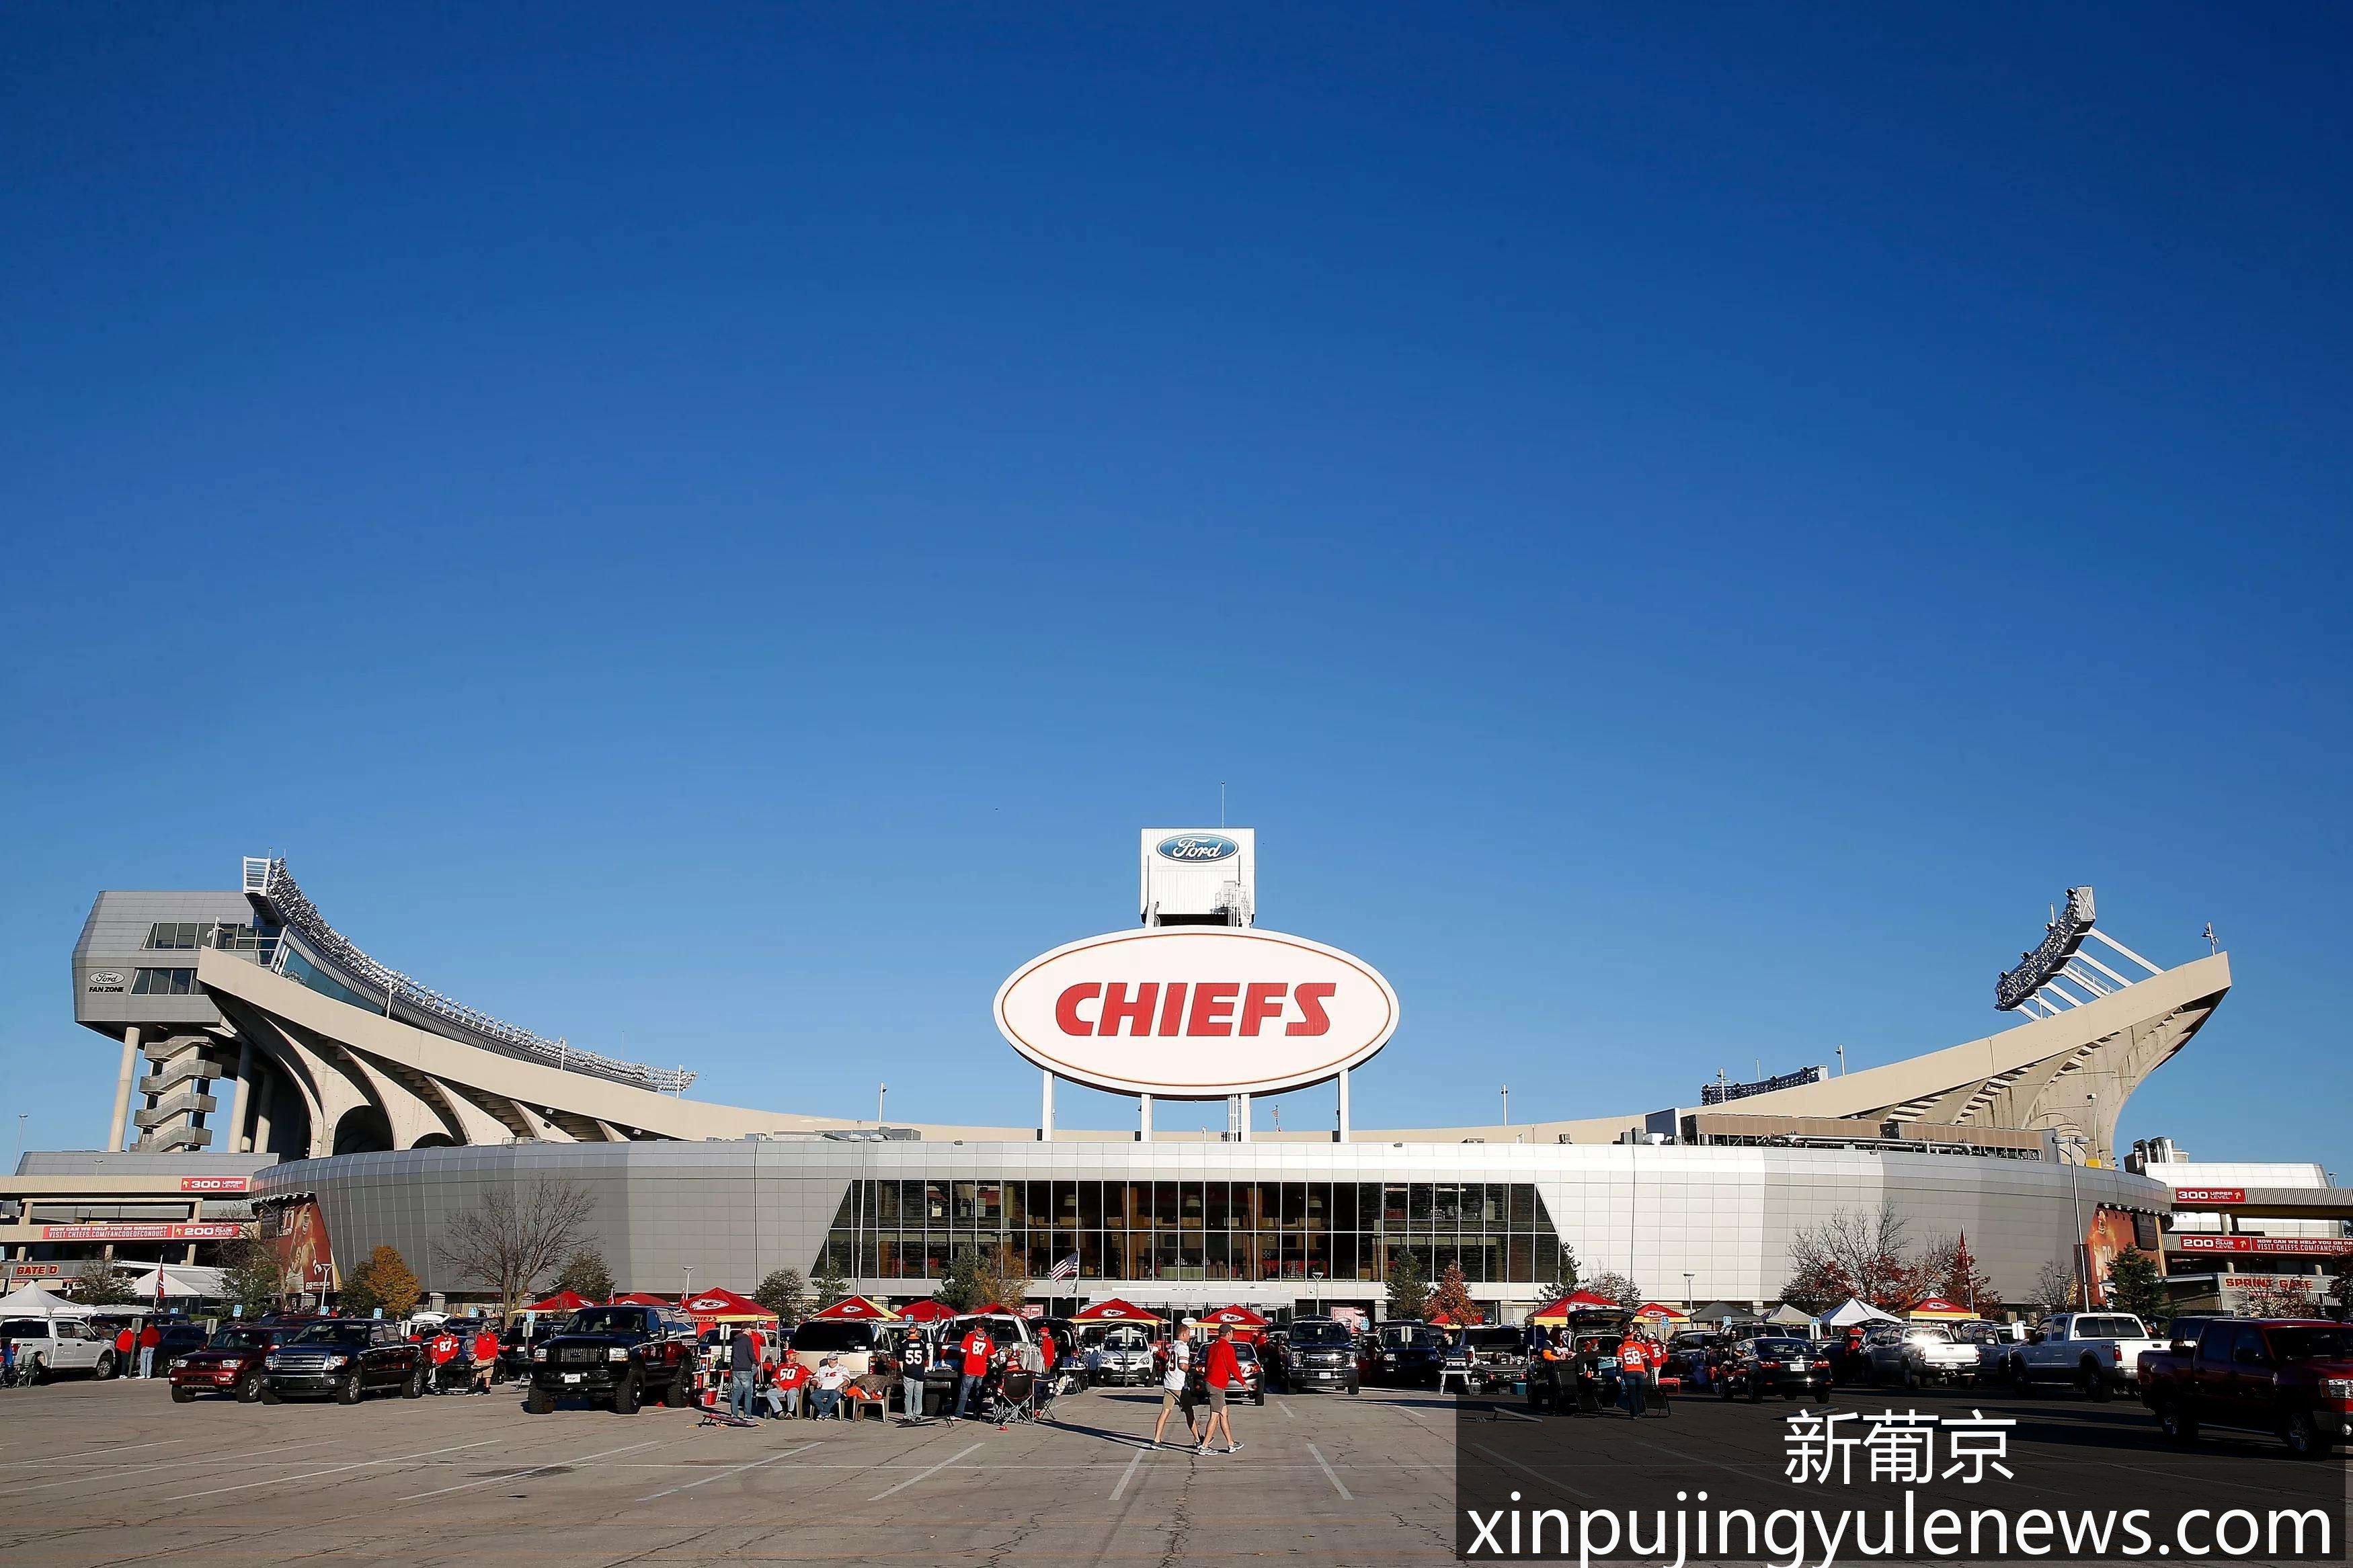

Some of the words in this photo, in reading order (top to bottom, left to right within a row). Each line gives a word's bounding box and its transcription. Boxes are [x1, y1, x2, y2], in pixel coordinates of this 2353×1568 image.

[1172, 837, 1223, 858] Ford
[96, 973, 118, 982] Ford
[1055, 983, 1337, 1036] CHIEFS
[191, 1180, 221, 1188] 300
[2178, 1191, 2208, 1200] 300
[184, 1227, 214, 1236] 200
[2183, 1239, 2214, 1247] 200
[16, 1266, 46, 1276] GATE
[49, 1264, 58, 1275] D
[305, 1282, 313, 1290] 68
[2225, 1277, 2273, 1288] SPRINT
[439, 1340, 452, 1352] 87
[972, 1341, 986, 1356] 87
[905, 1350, 922, 1365] 55
[1624, 1350, 1641, 1364] 58
[1654, 1348, 1661, 1358] 15
[780, 1368, 797, 1381] 50
